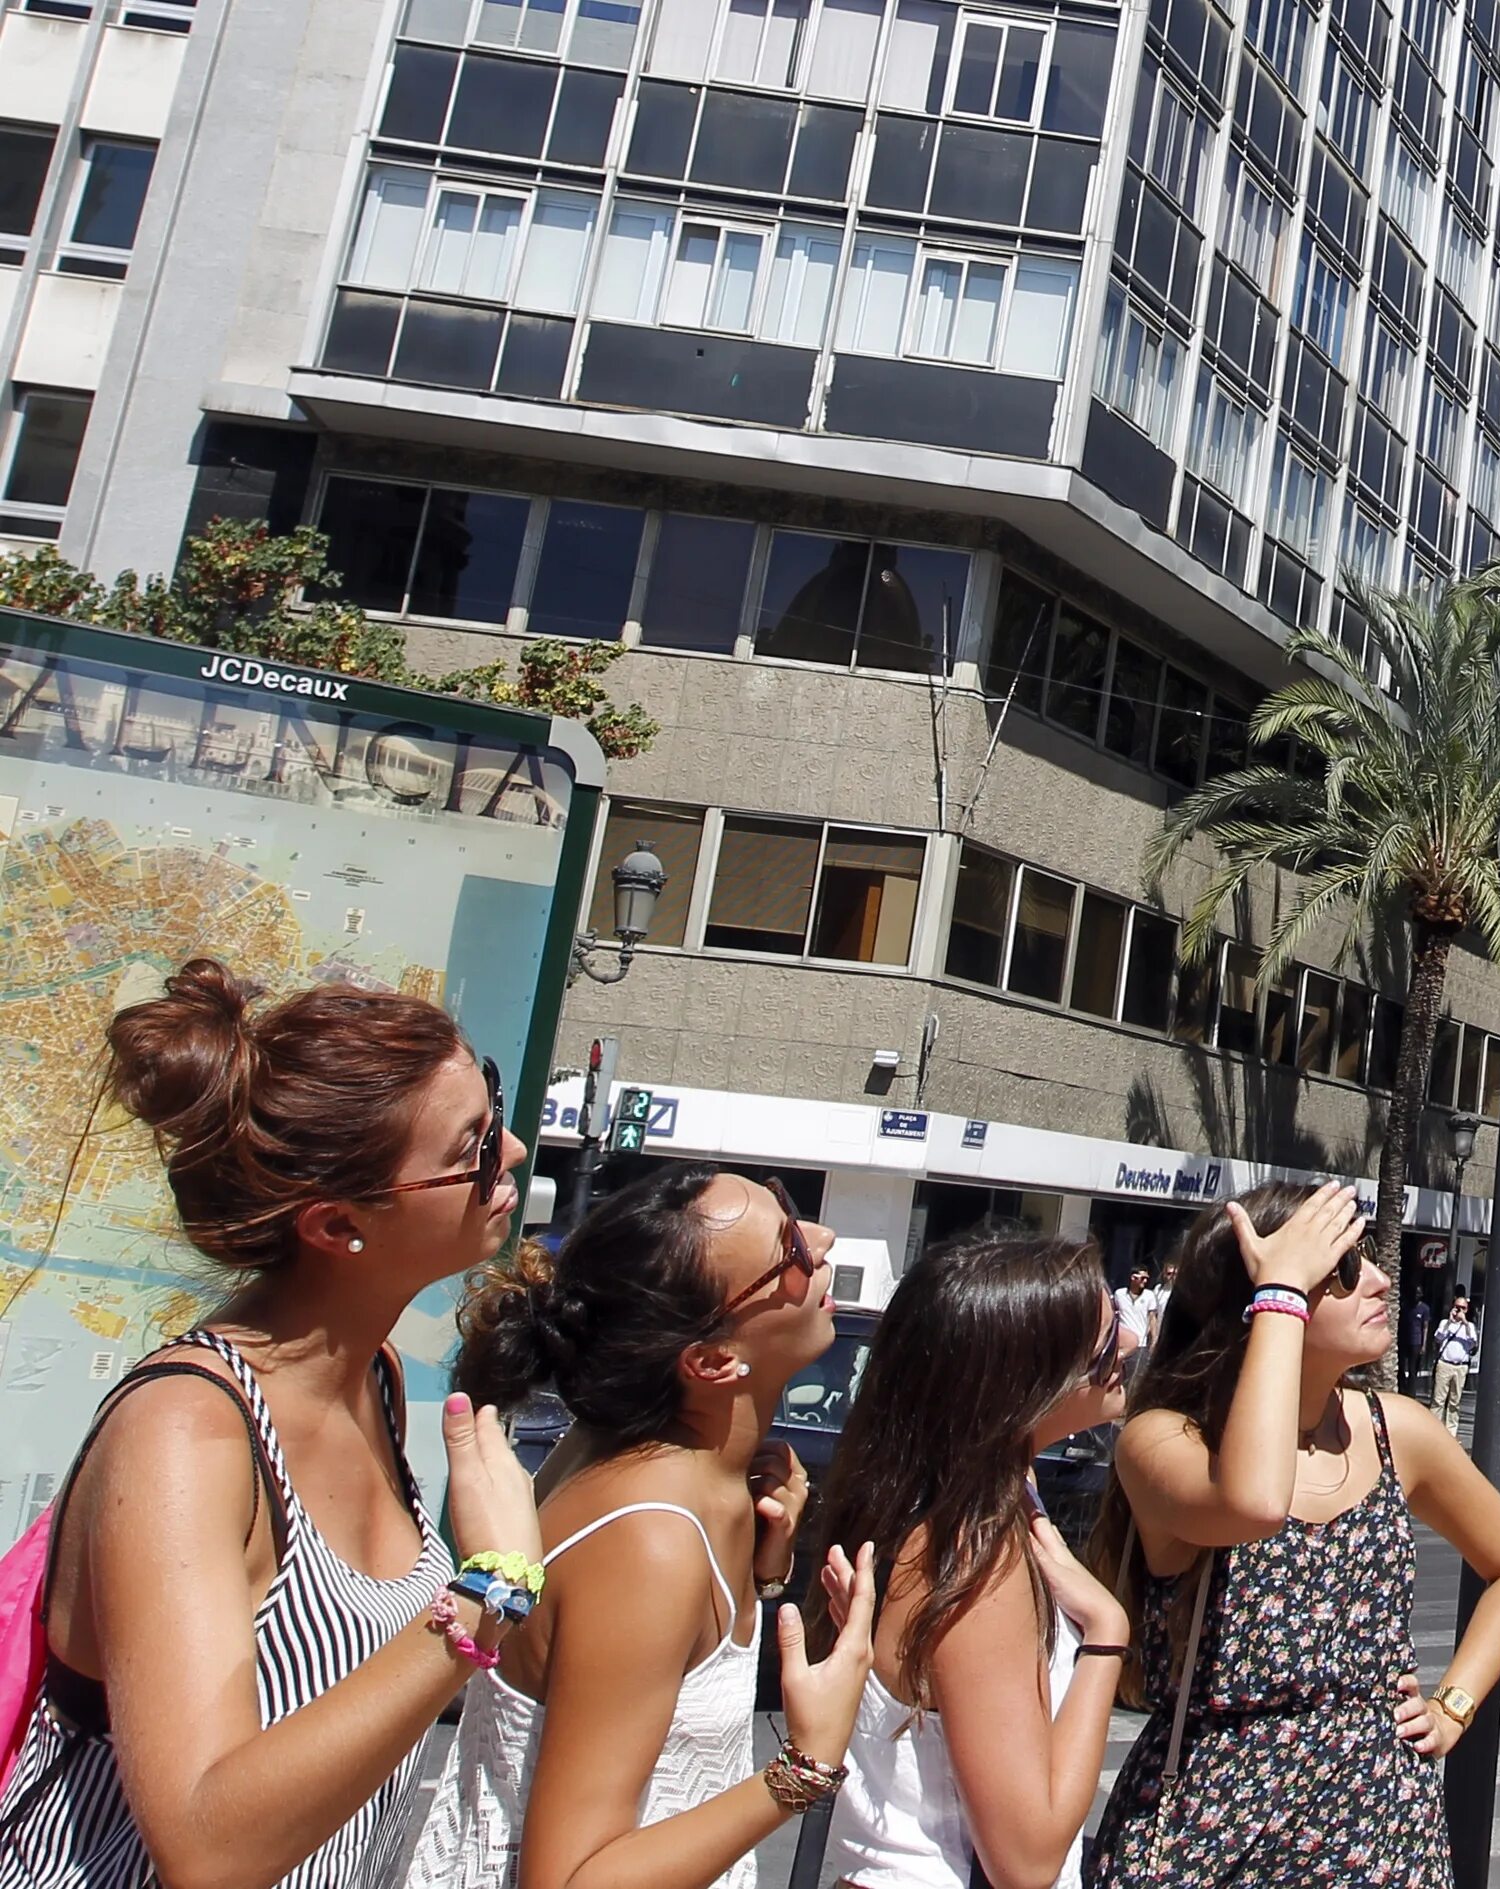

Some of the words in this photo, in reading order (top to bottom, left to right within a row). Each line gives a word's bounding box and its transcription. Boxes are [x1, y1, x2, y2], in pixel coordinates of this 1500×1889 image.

[200, 655, 349, 701] JCDecaux
[0, 648, 556, 828] ALENCIA
[898, 1114, 917, 1122] PLAÇA
[1115, 1163, 1171, 1194] Deutsche
[1172, 1170, 1203, 1196] Bank
